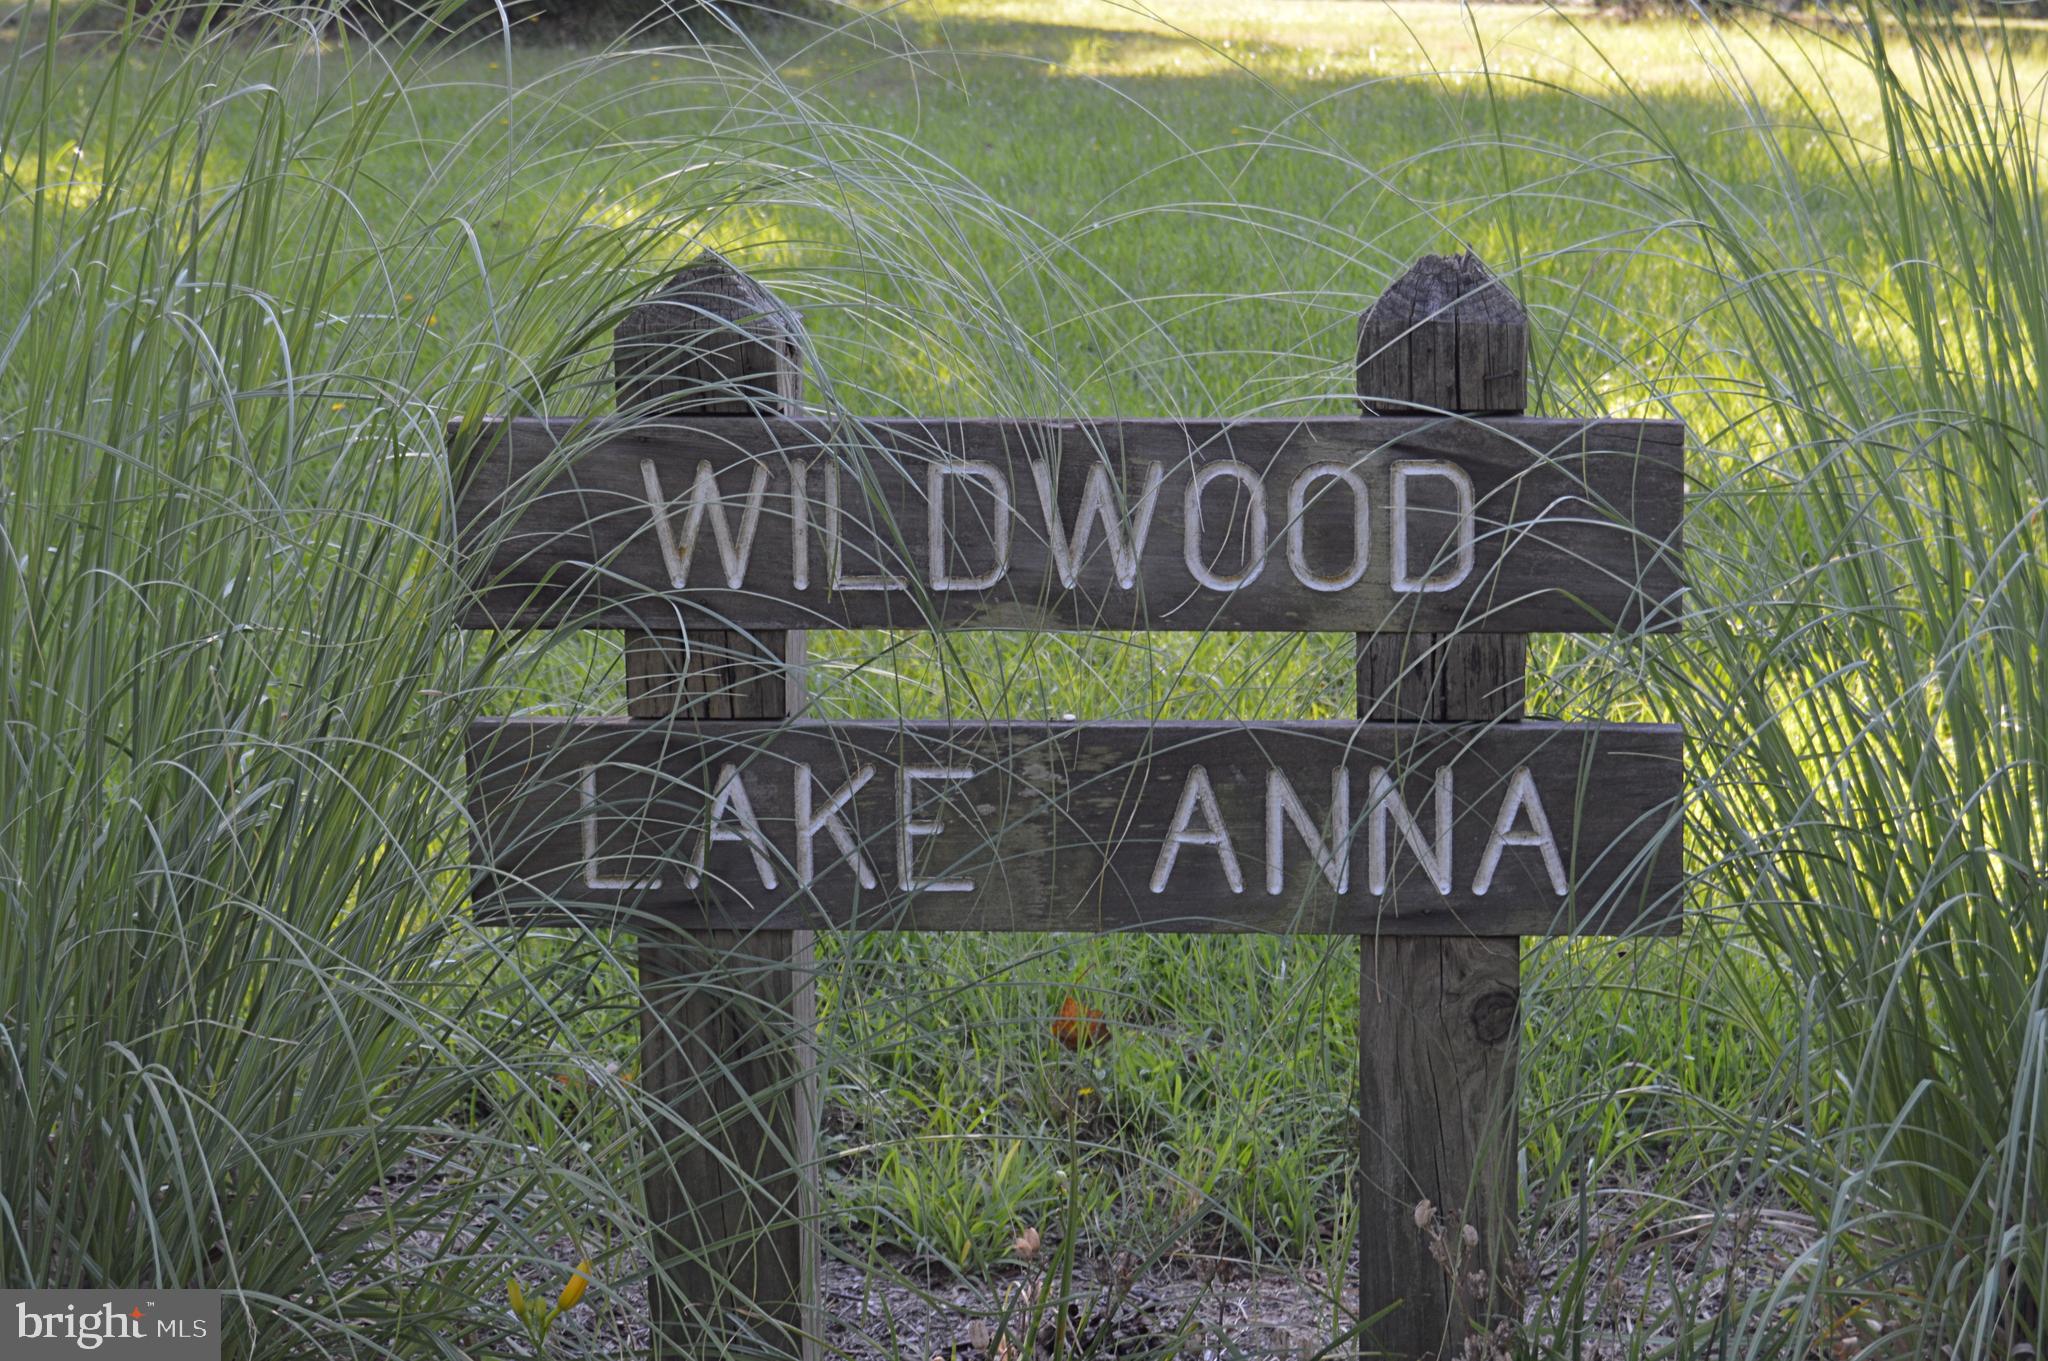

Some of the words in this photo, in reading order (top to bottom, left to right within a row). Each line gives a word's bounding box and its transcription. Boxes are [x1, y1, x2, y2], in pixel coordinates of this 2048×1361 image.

[640, 458, 1476, 592] WILDWOOD
[580, 761, 976, 892] LAKE
[1149, 763, 1569, 896] ANNA
